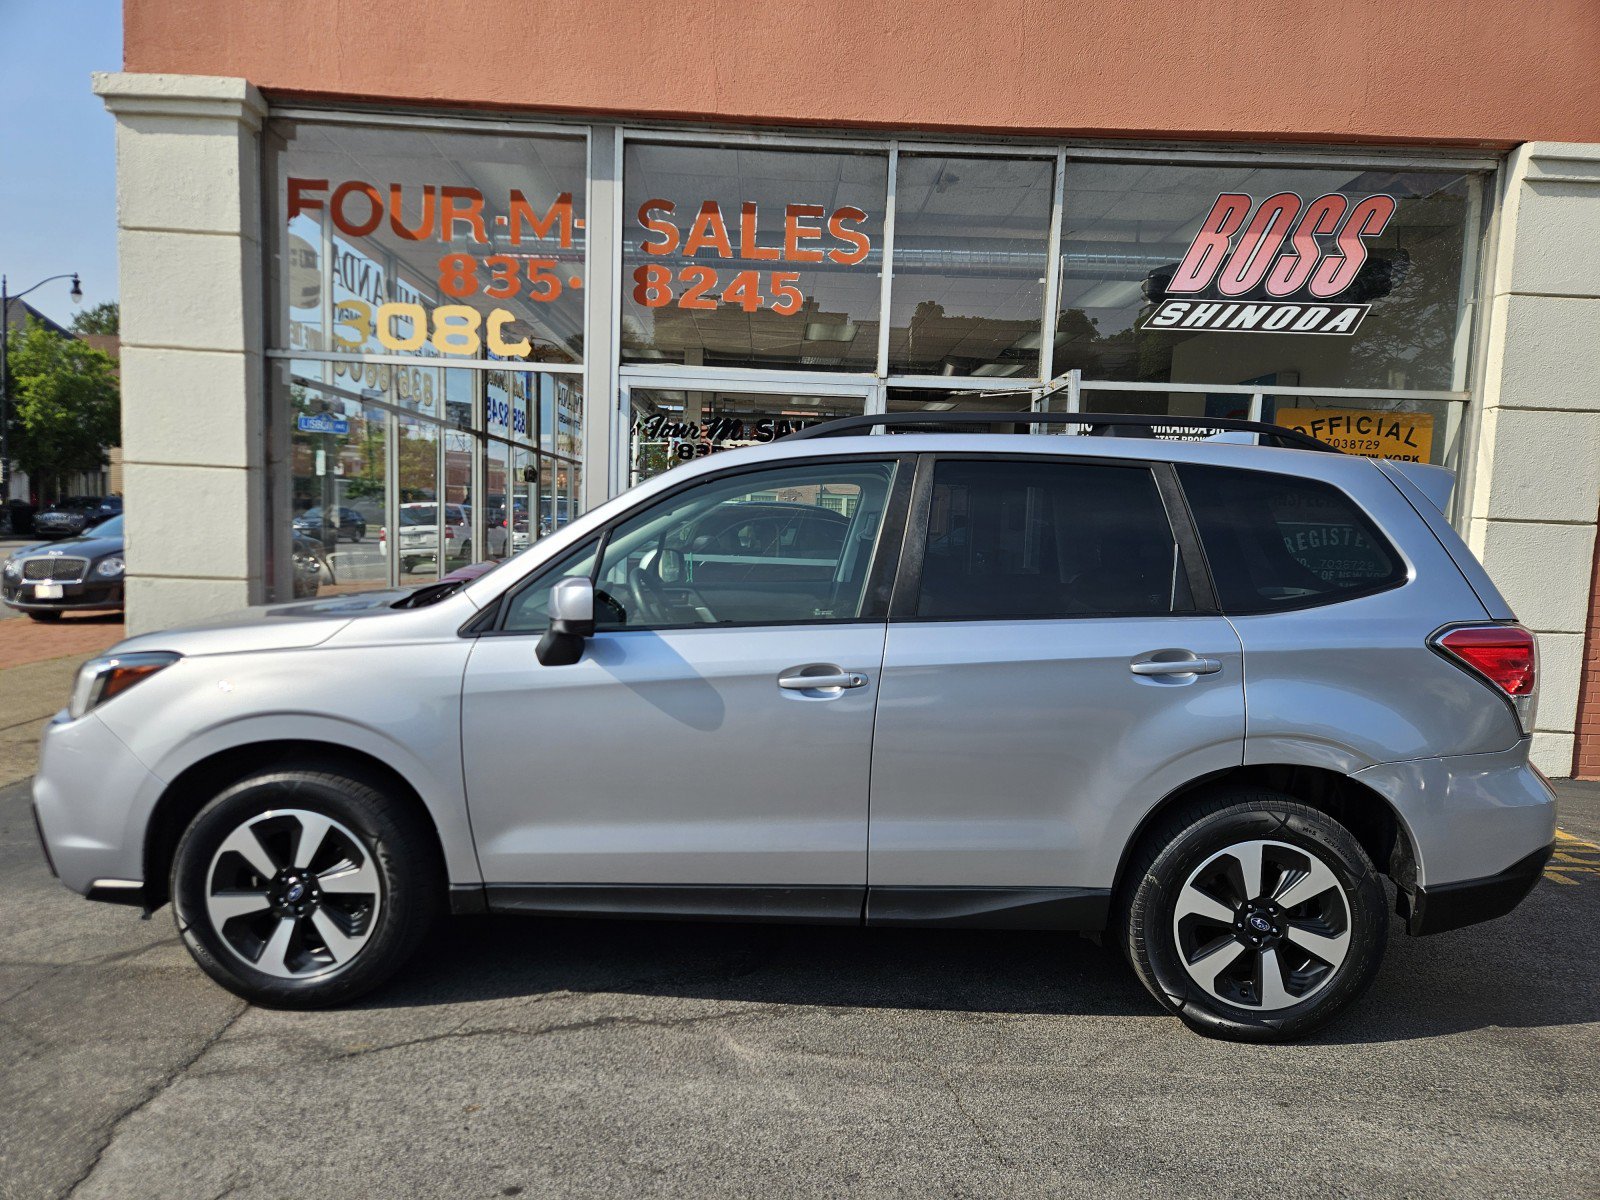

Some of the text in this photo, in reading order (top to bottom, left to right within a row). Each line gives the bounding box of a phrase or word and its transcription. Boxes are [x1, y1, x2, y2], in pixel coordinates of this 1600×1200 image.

[637, 198, 871, 265] SALES
[1165, 191, 1397, 298] BOSS
[632, 264, 803, 316] 8245
[1152, 302, 1362, 332] SHINODA
[1291, 415, 1418, 448] OFFICIAL
[1325, 438, 1380, 450] 7038729
